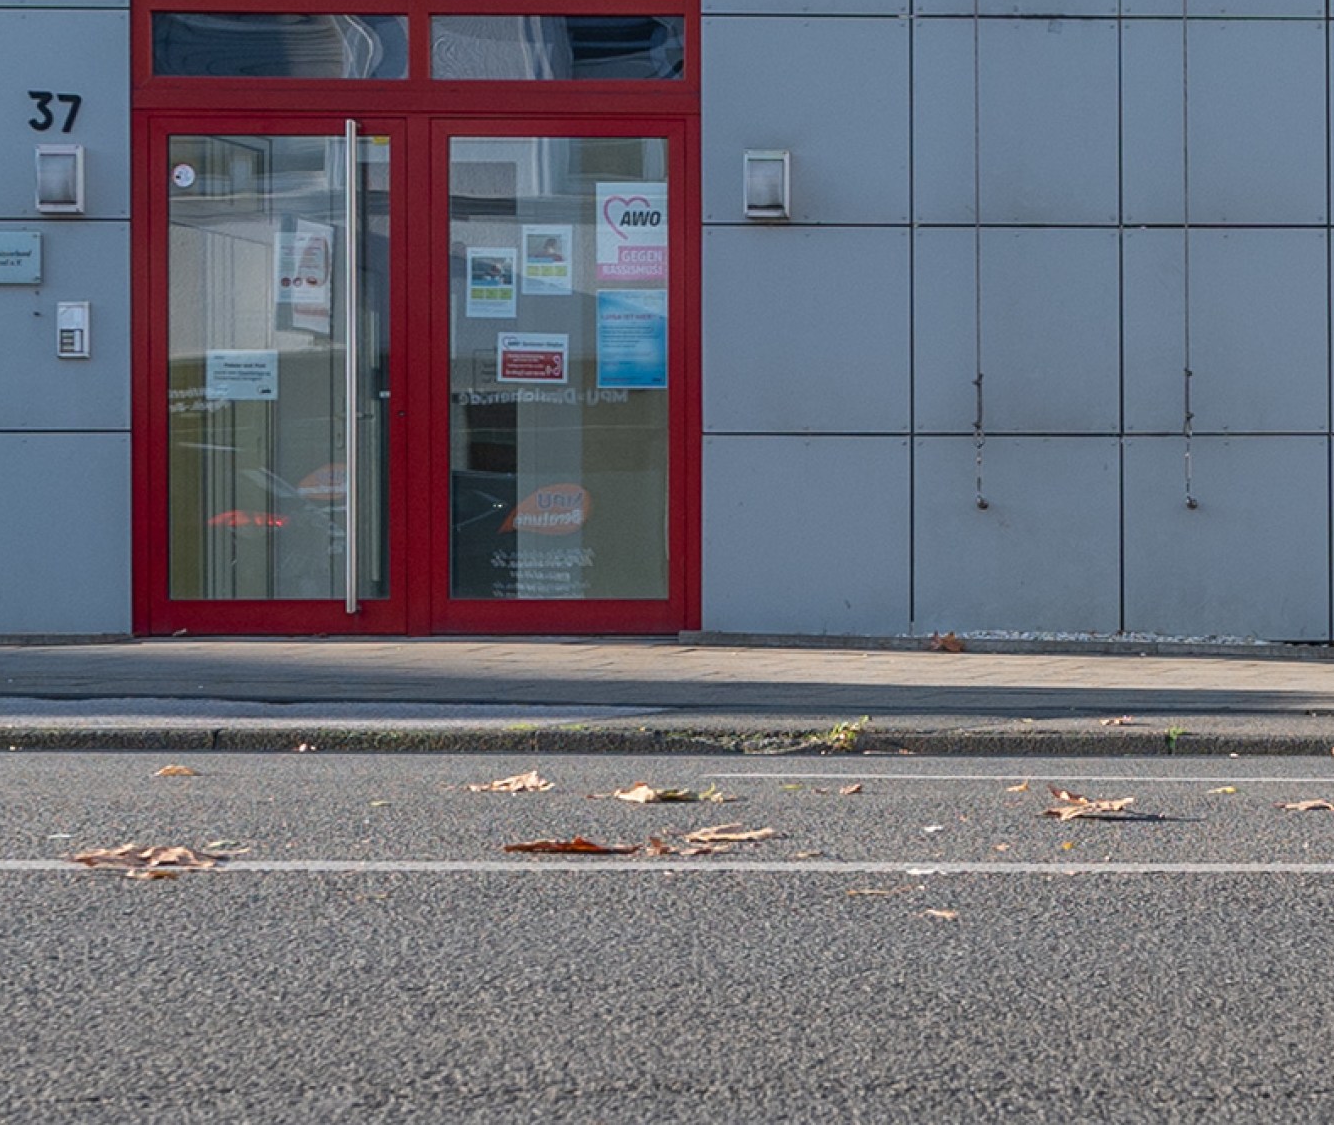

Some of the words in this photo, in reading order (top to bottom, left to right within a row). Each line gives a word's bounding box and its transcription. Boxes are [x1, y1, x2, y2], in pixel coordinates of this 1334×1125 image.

[27, 90, 82, 133] 37
[619, 211, 662, 227] AWO
[621, 250, 663, 262] GEGEN
